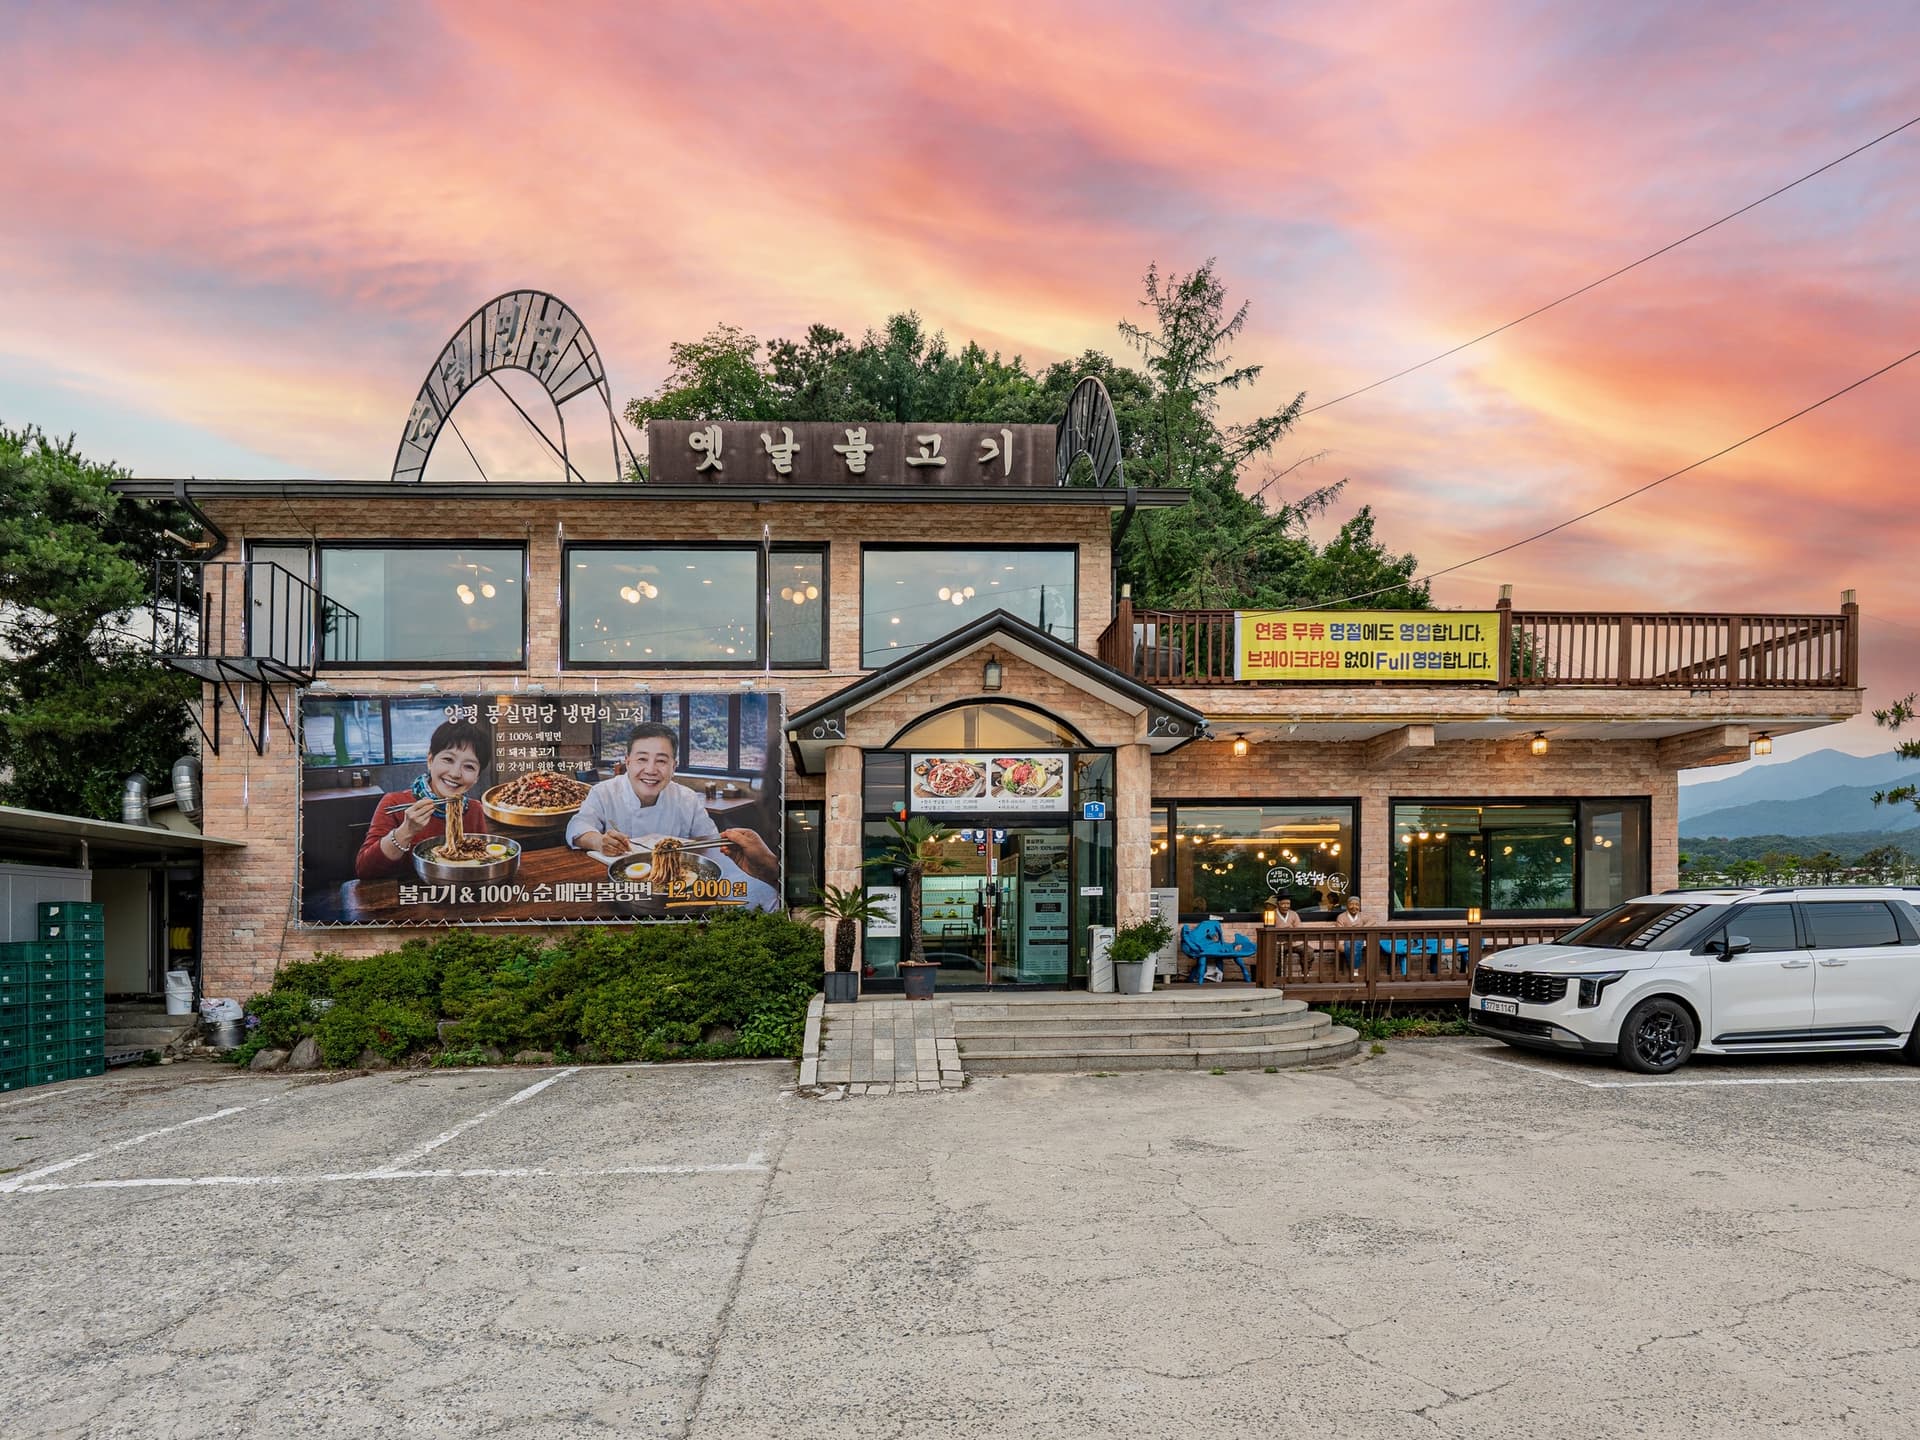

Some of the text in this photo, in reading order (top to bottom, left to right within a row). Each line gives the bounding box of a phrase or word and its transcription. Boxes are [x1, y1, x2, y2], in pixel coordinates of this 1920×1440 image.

[1255, 622, 1485, 642] 연중 무휴 명절에도 영업합니다.
[1247, 650, 1340, 669] 브레이크타임
[444, 703, 645, 724] 양평 몽실면당 냉면의 고집
[508, 732, 533, 742] 100%
[508, 747, 555, 757] 돼지 불고기
[537, 761, 555, 772] 위한
[557, 761, 593, 772] 연구개발
[1090, 804, 1100, 812] 15
[399, 884, 456, 905] 불고기
[459, 886, 476, 903] &
[479, 884, 530, 903] 100%
[532, 883, 552, 903] 순
[555, 882, 593, 902] 메밀
[596, 881, 652, 902] 물냉면
